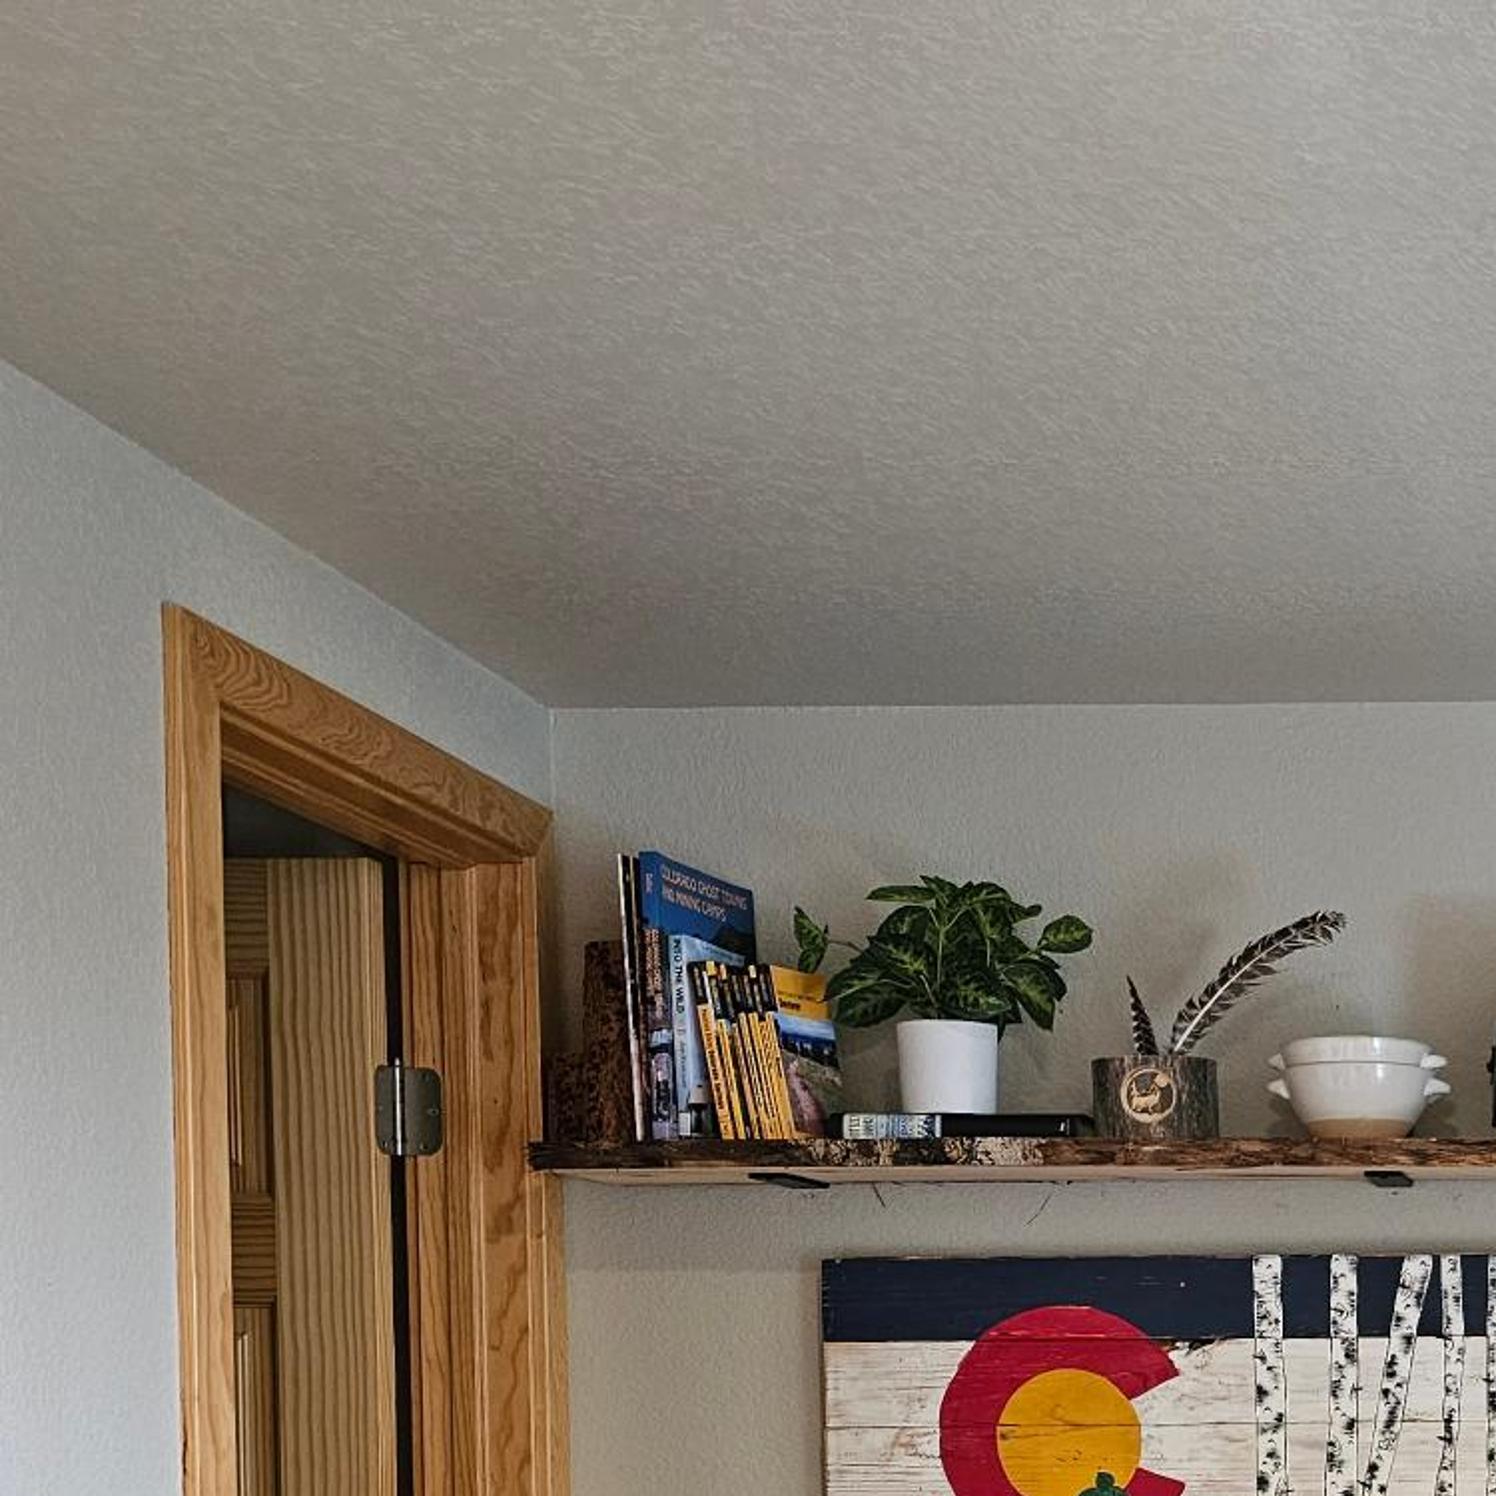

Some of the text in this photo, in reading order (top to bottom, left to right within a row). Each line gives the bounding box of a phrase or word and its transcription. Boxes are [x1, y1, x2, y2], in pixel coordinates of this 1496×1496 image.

[672, 938, 686, 1015] INTO THE WILD
